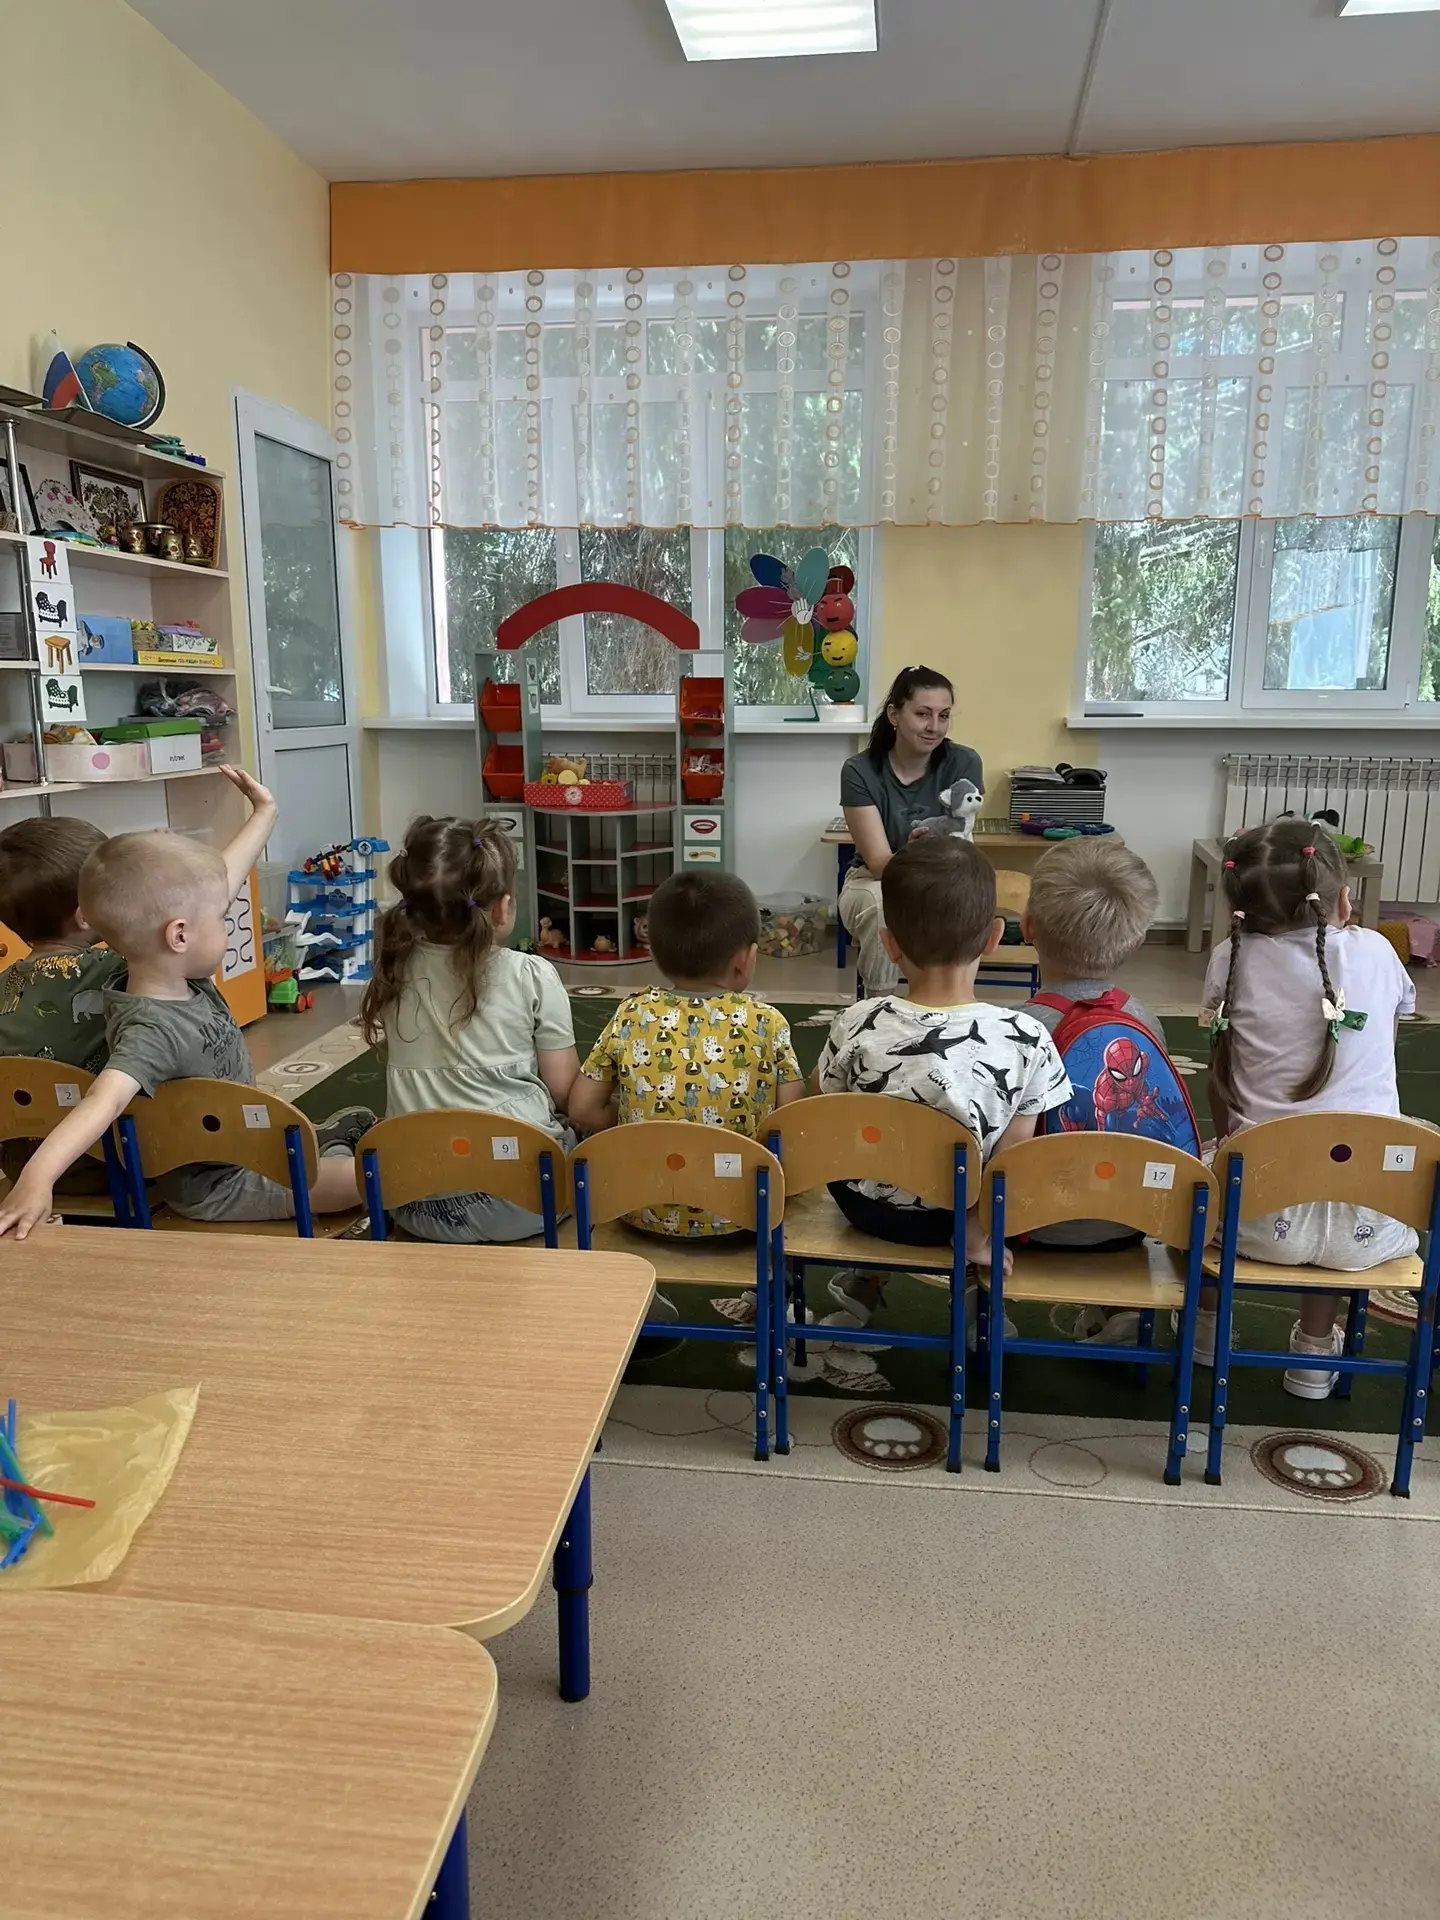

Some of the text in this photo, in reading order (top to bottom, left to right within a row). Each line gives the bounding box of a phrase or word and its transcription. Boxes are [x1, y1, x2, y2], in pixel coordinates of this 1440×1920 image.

[65, 1091, 72, 1100] 2
[254, 1112, 260, 1122] 1
[502, 1144, 509, 1154] 9
[1395, 1154, 1404, 1164] 6
[724, 1161, 731, 1170] 7
[1153, 1171, 1167, 1181] 17
